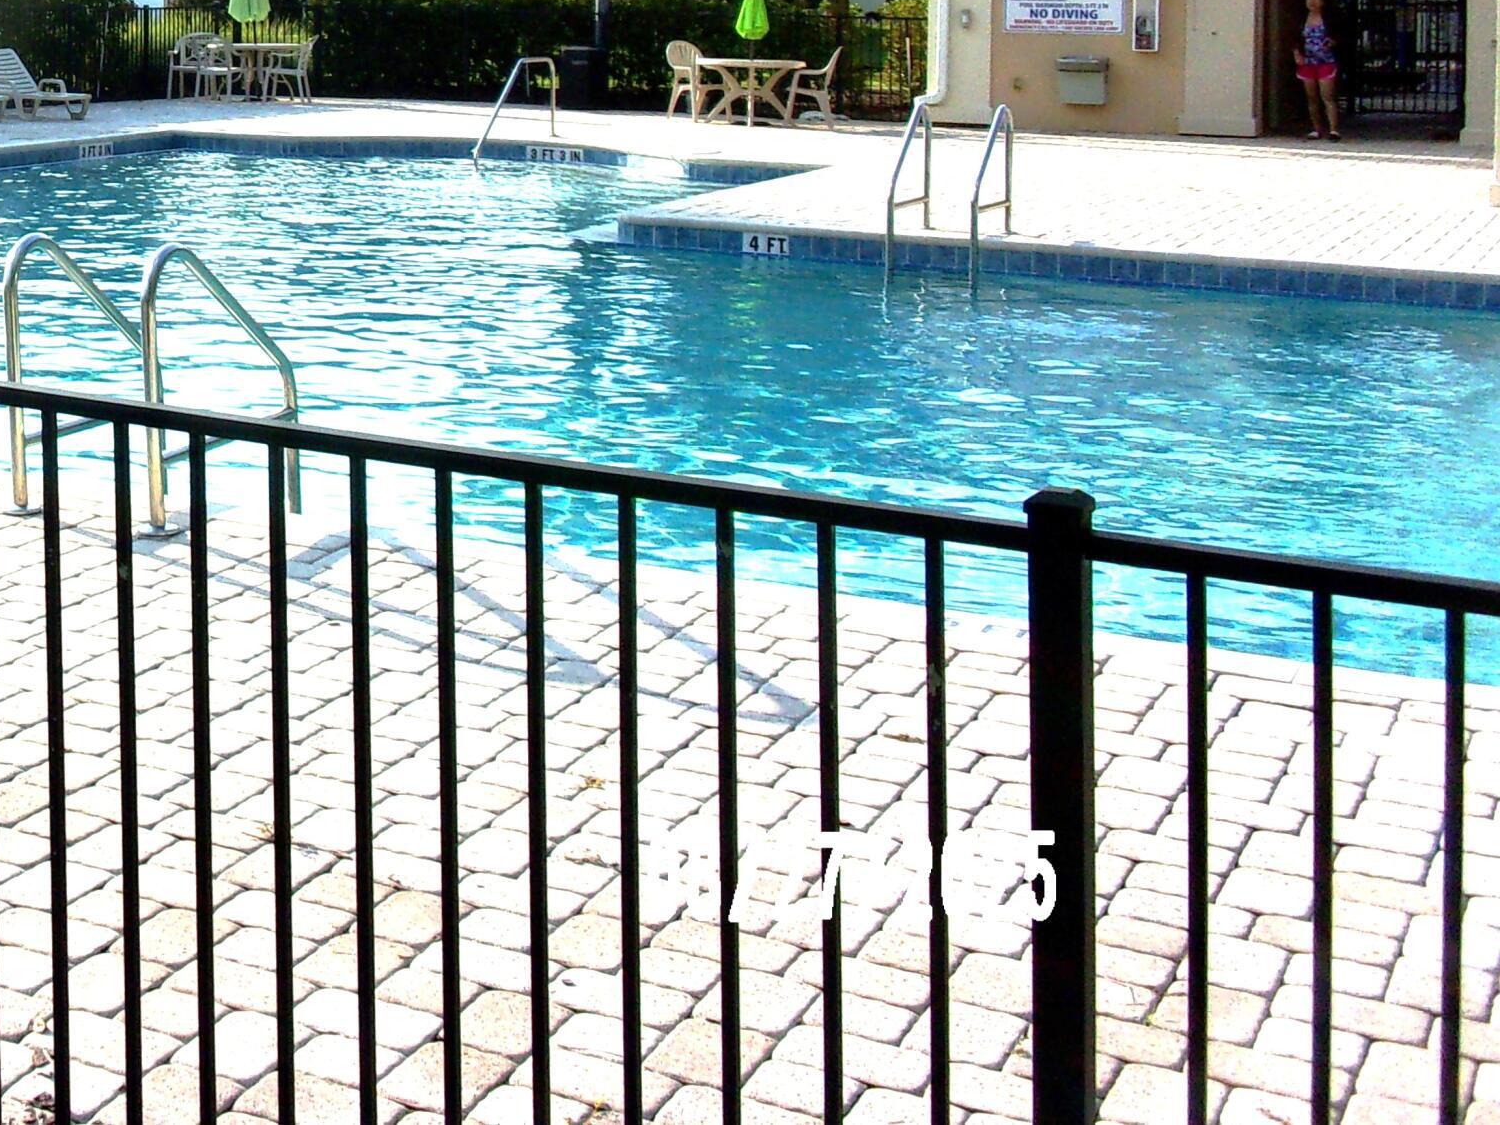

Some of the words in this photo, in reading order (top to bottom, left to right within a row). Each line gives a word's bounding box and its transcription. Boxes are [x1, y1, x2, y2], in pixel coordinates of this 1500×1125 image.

[1030, 9, 1048, 18] NO
[1052, 9, 1098, 19] DIVING
[530, 148, 538, 161] 3
[542, 149, 555, 161] FT
[570, 150, 581, 163] IN
[749, 235, 759, 252] 4
[767, 236, 787, 254] FT
